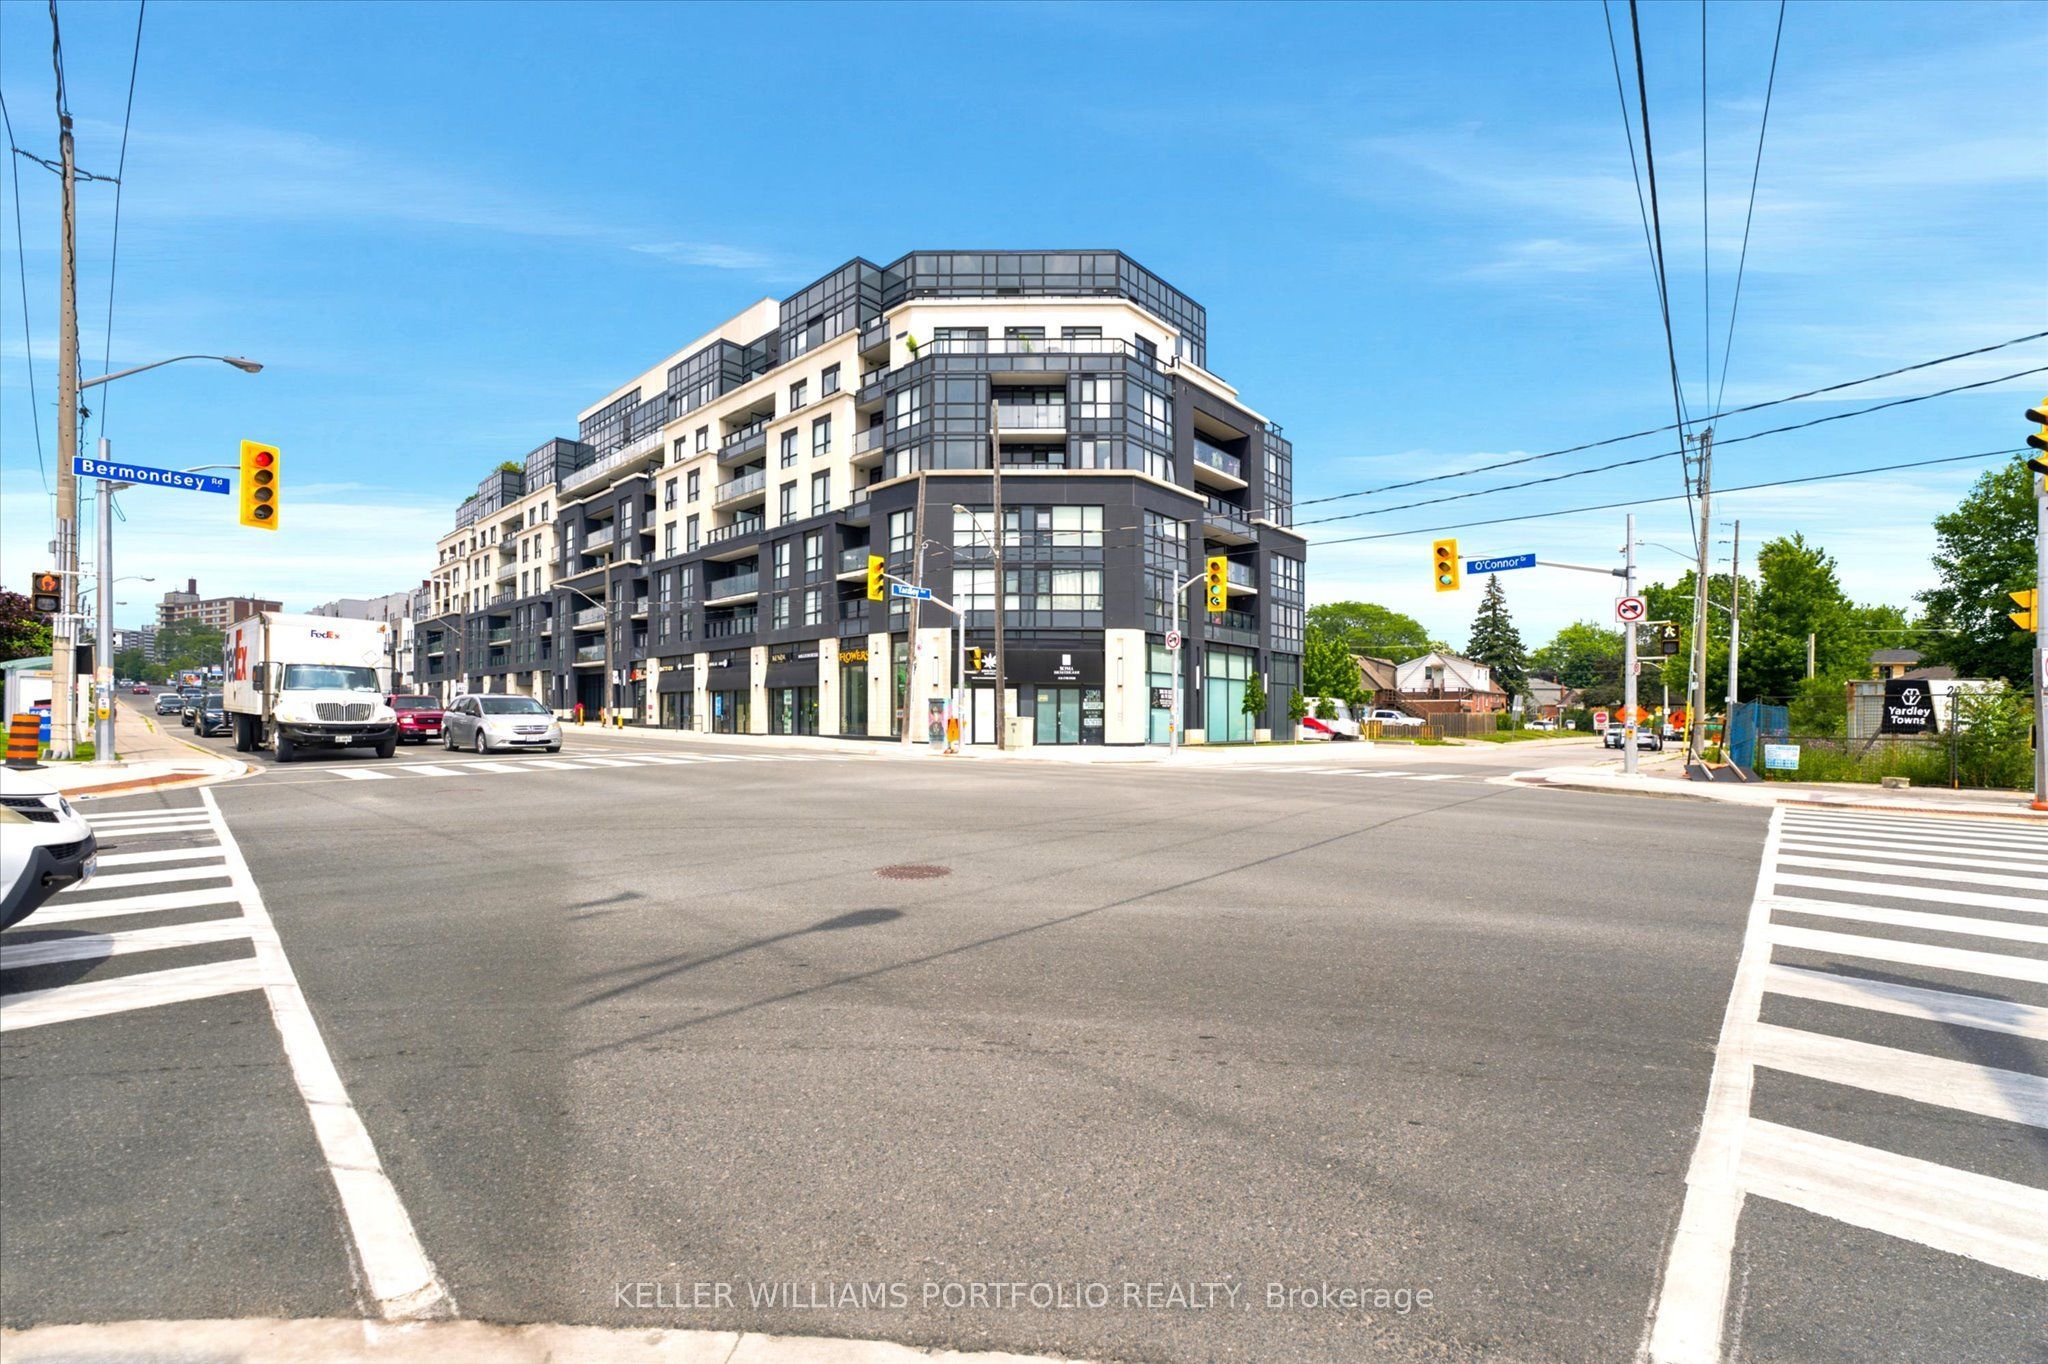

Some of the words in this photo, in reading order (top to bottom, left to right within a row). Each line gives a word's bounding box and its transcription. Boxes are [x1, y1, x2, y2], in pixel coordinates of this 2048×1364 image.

[82, 459, 205, 491] Bermondsey
[1474, 558, 1520, 571] O'Connor
[310, 629, 341, 640] FedEx
[839, 649, 869, 664] FLOWERS
[1888, 706, 1931, 718] Yardley
[1890, 715, 1926, 725] Towns
